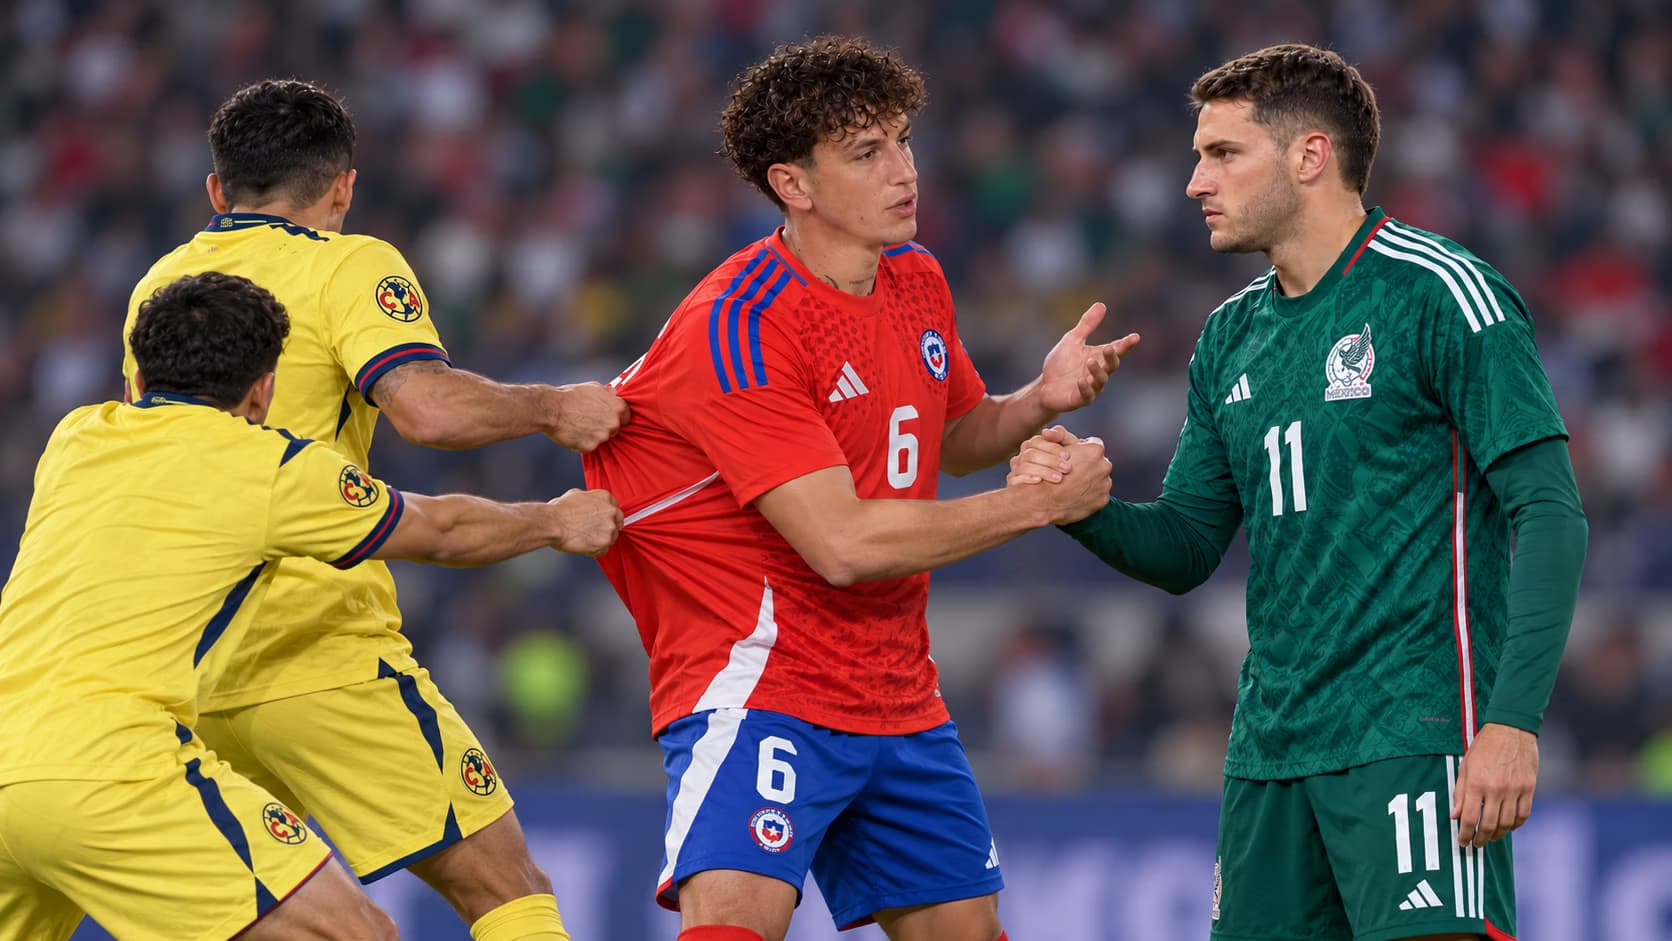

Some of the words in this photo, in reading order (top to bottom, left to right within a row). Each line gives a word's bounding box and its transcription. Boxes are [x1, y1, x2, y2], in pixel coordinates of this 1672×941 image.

[887, 405, 919, 489] 6
[1264, 420, 1307, 516] 11
[756, 735, 798, 805] 6
[1388, 791, 1440, 874] 11
